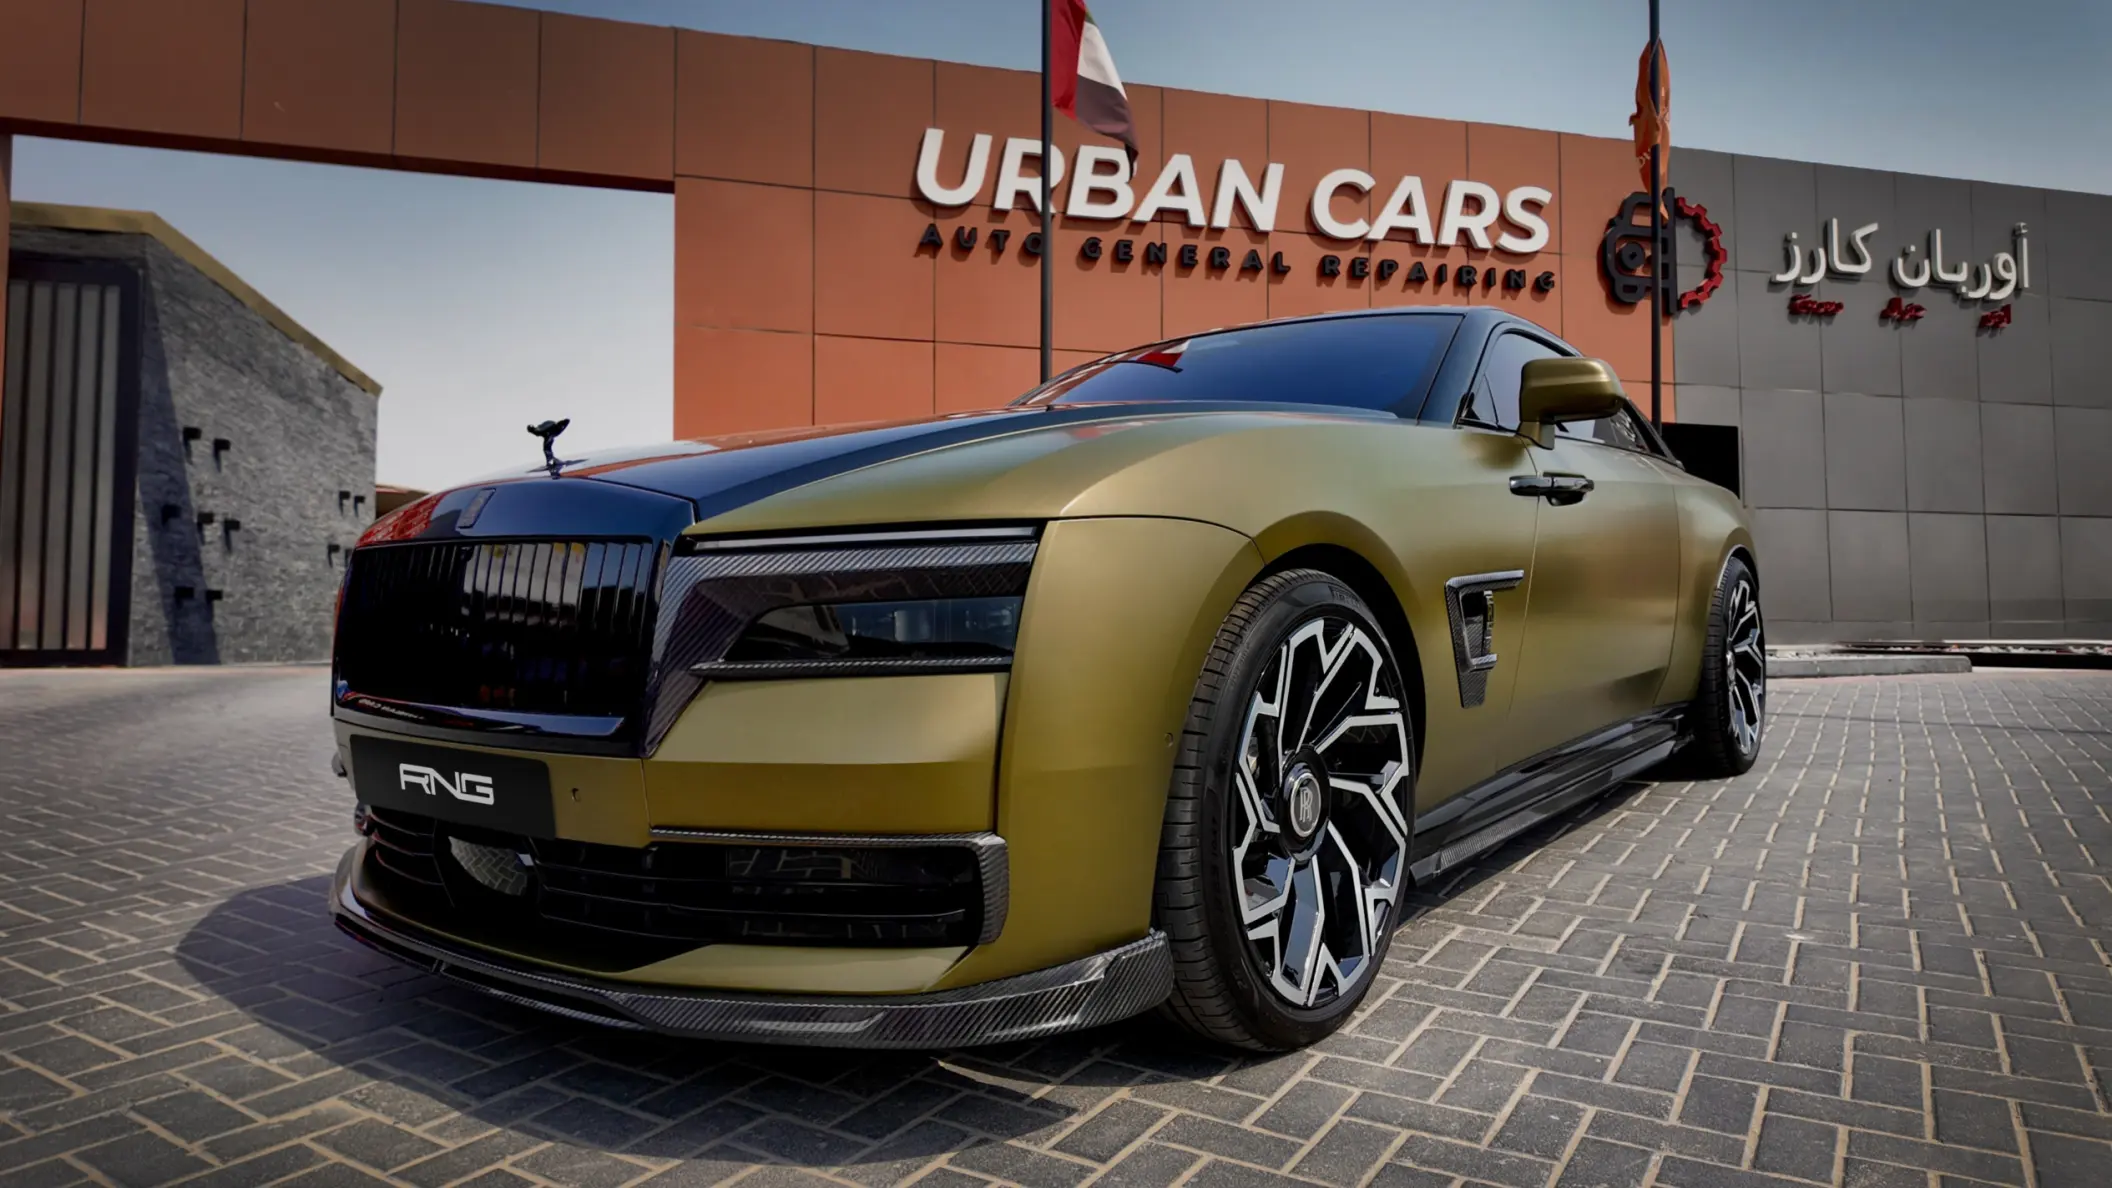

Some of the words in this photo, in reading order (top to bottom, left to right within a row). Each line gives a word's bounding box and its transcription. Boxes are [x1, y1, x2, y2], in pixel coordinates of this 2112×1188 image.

[916, 128, 1286, 232] URBAN
[1312, 168, 1554, 254] CARS
[919, 223, 1042, 257] AUTO
[1080, 237, 1291, 277] GENERAL
[1318, 255, 1556, 294] REPAIRING
[1774, 217, 1879, 285] كارز
[1896, 221, 2030, 300] أوربان
[399, 763, 495, 806] RNG
